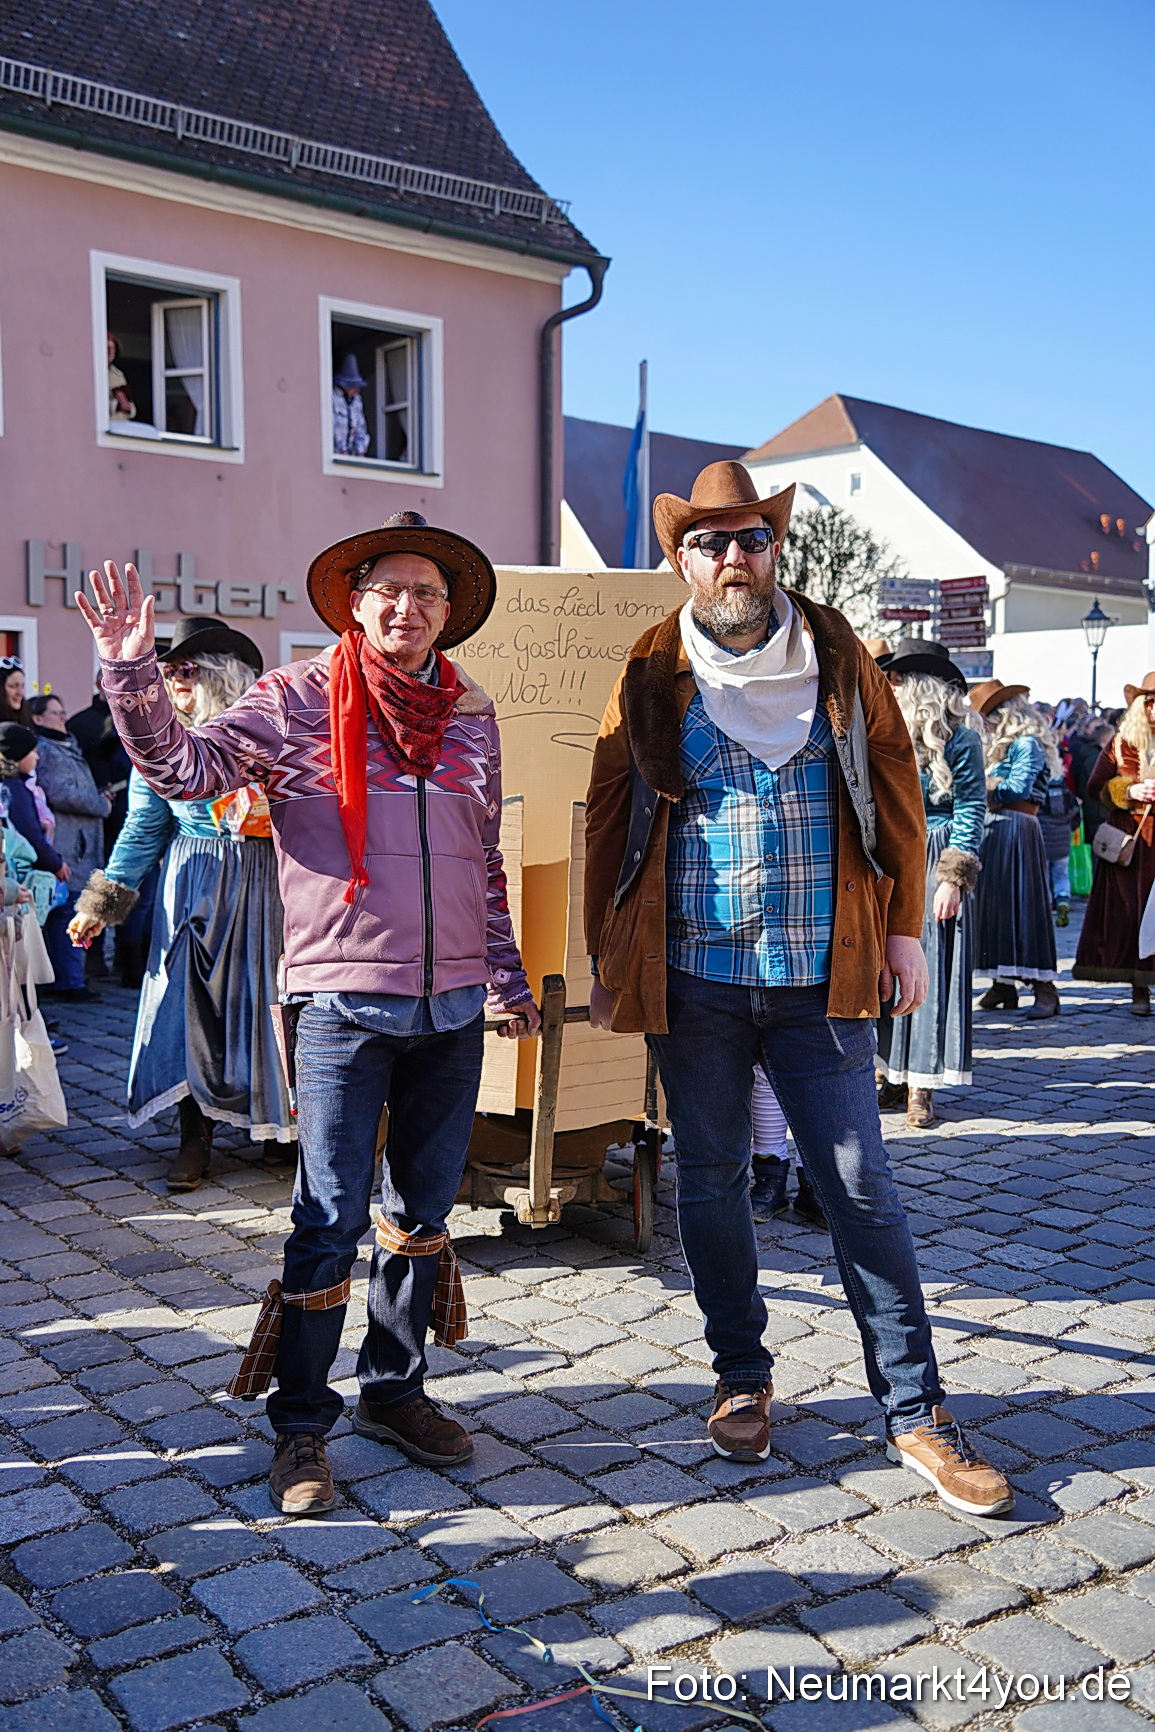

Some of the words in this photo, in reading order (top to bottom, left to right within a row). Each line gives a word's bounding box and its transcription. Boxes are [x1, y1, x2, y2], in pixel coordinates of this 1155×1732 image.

[506, 588, 550, 614] das
[553, 586, 606, 617] Lied
[614, 600, 671, 618] vom
